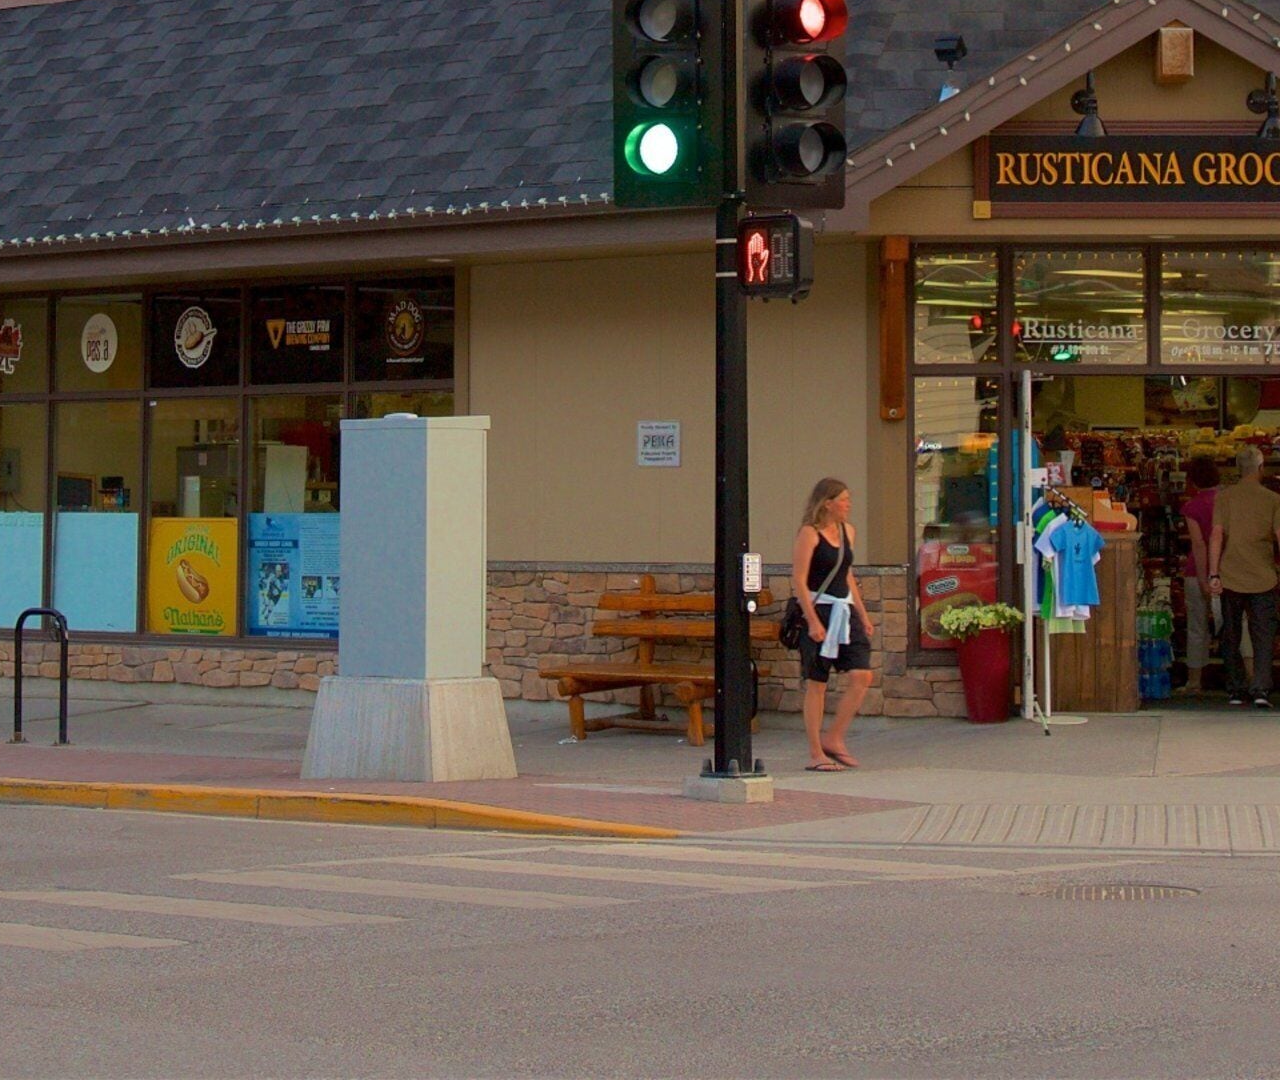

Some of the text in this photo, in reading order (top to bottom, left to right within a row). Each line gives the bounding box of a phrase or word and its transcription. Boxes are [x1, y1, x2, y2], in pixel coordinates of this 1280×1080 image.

[995, 151, 1185, 186] RUSTICANA
[1022, 318, 1276, 342] Rusticana Grocery
[164, 607, 225, 628] Nathan's
